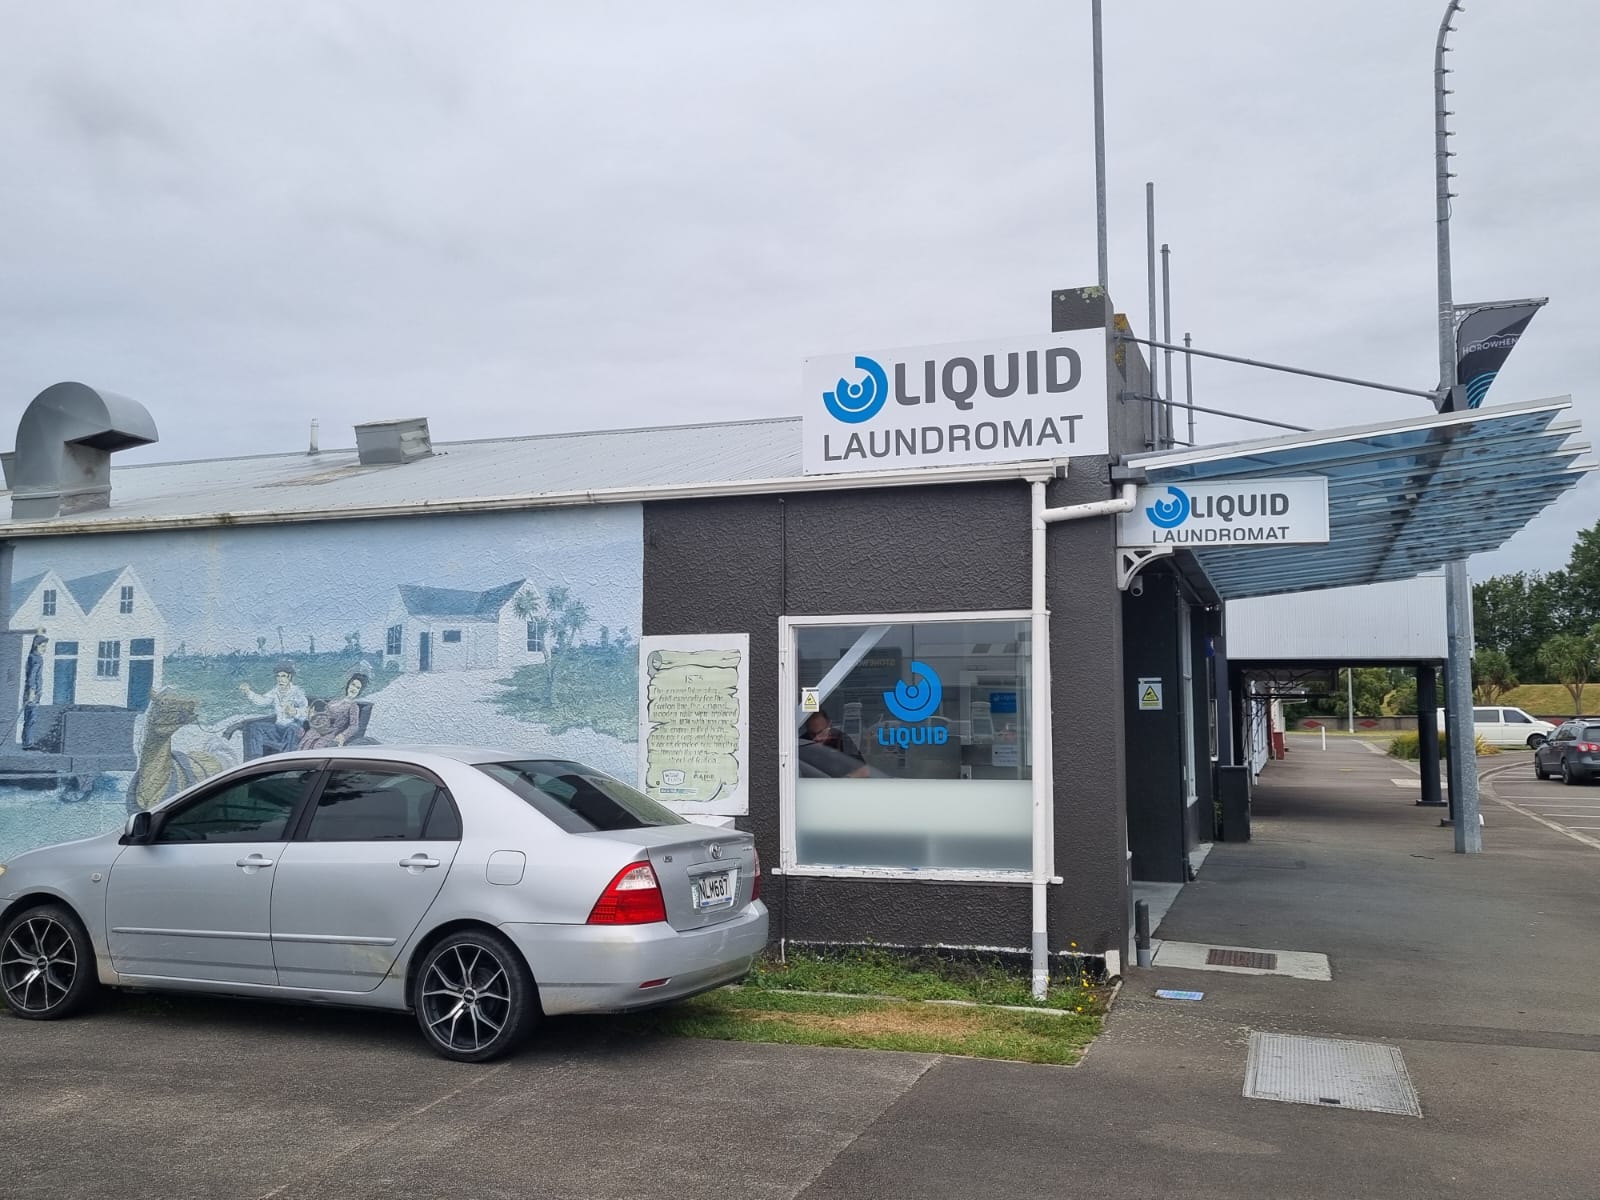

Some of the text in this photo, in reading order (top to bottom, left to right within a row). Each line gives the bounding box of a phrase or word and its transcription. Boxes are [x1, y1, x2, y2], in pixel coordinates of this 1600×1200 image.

[894, 347, 1082, 411] LIQUID
[823, 414, 1084, 462] LAUNDROMAT
[1190, 493, 1290, 522] LIQUID
[1152, 526, 1290, 544] LAUNDROMAT
[878, 727, 949, 750] LIQUID
[699, 878, 728, 900] NLM687
